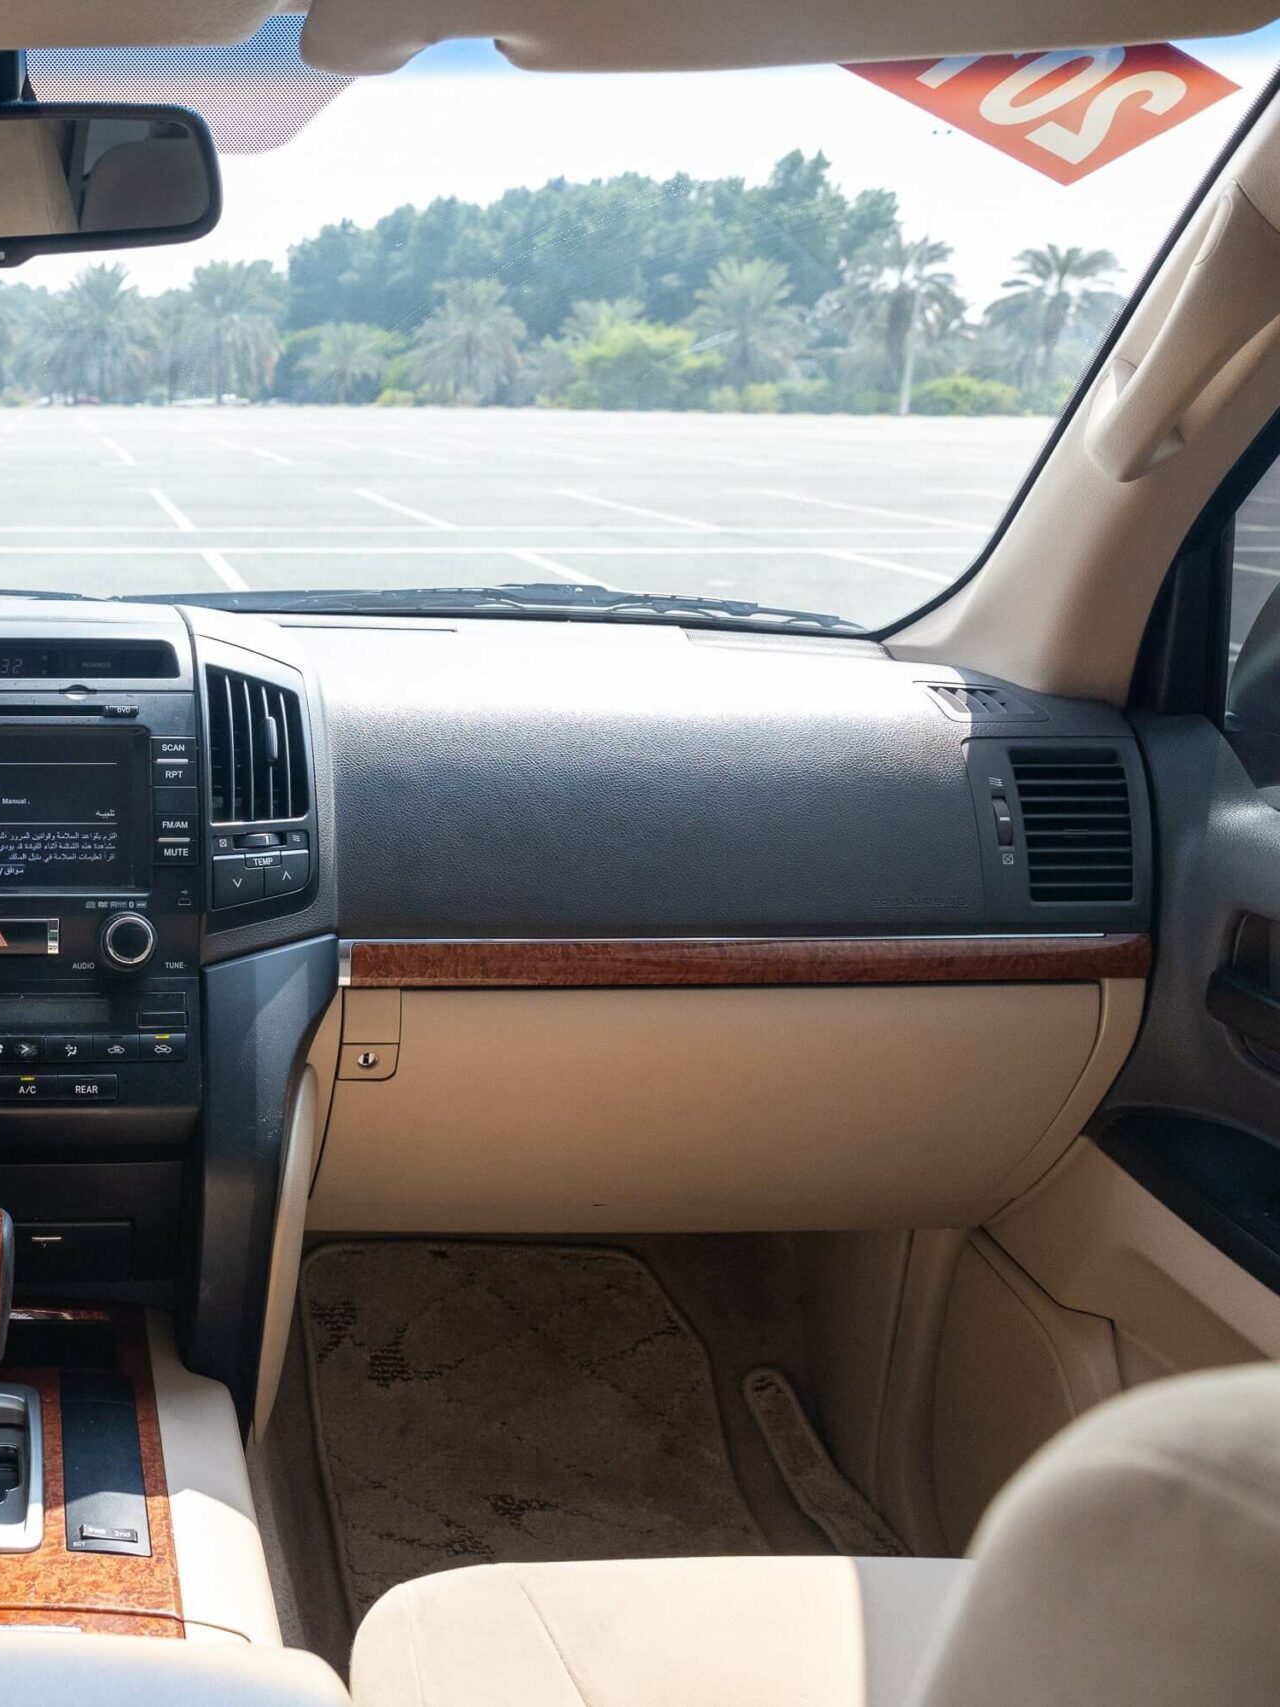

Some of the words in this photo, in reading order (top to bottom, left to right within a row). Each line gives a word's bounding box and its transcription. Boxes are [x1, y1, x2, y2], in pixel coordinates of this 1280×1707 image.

[165, 770, 183, 778] RPT
[162, 821, 188, 829] FM/AM
[164, 848, 189, 856] MUTE
[253, 857, 273, 866] TEMP
[18, 1085, 36, 1095] A/C
[75, 1085, 98, 1094] REAR
